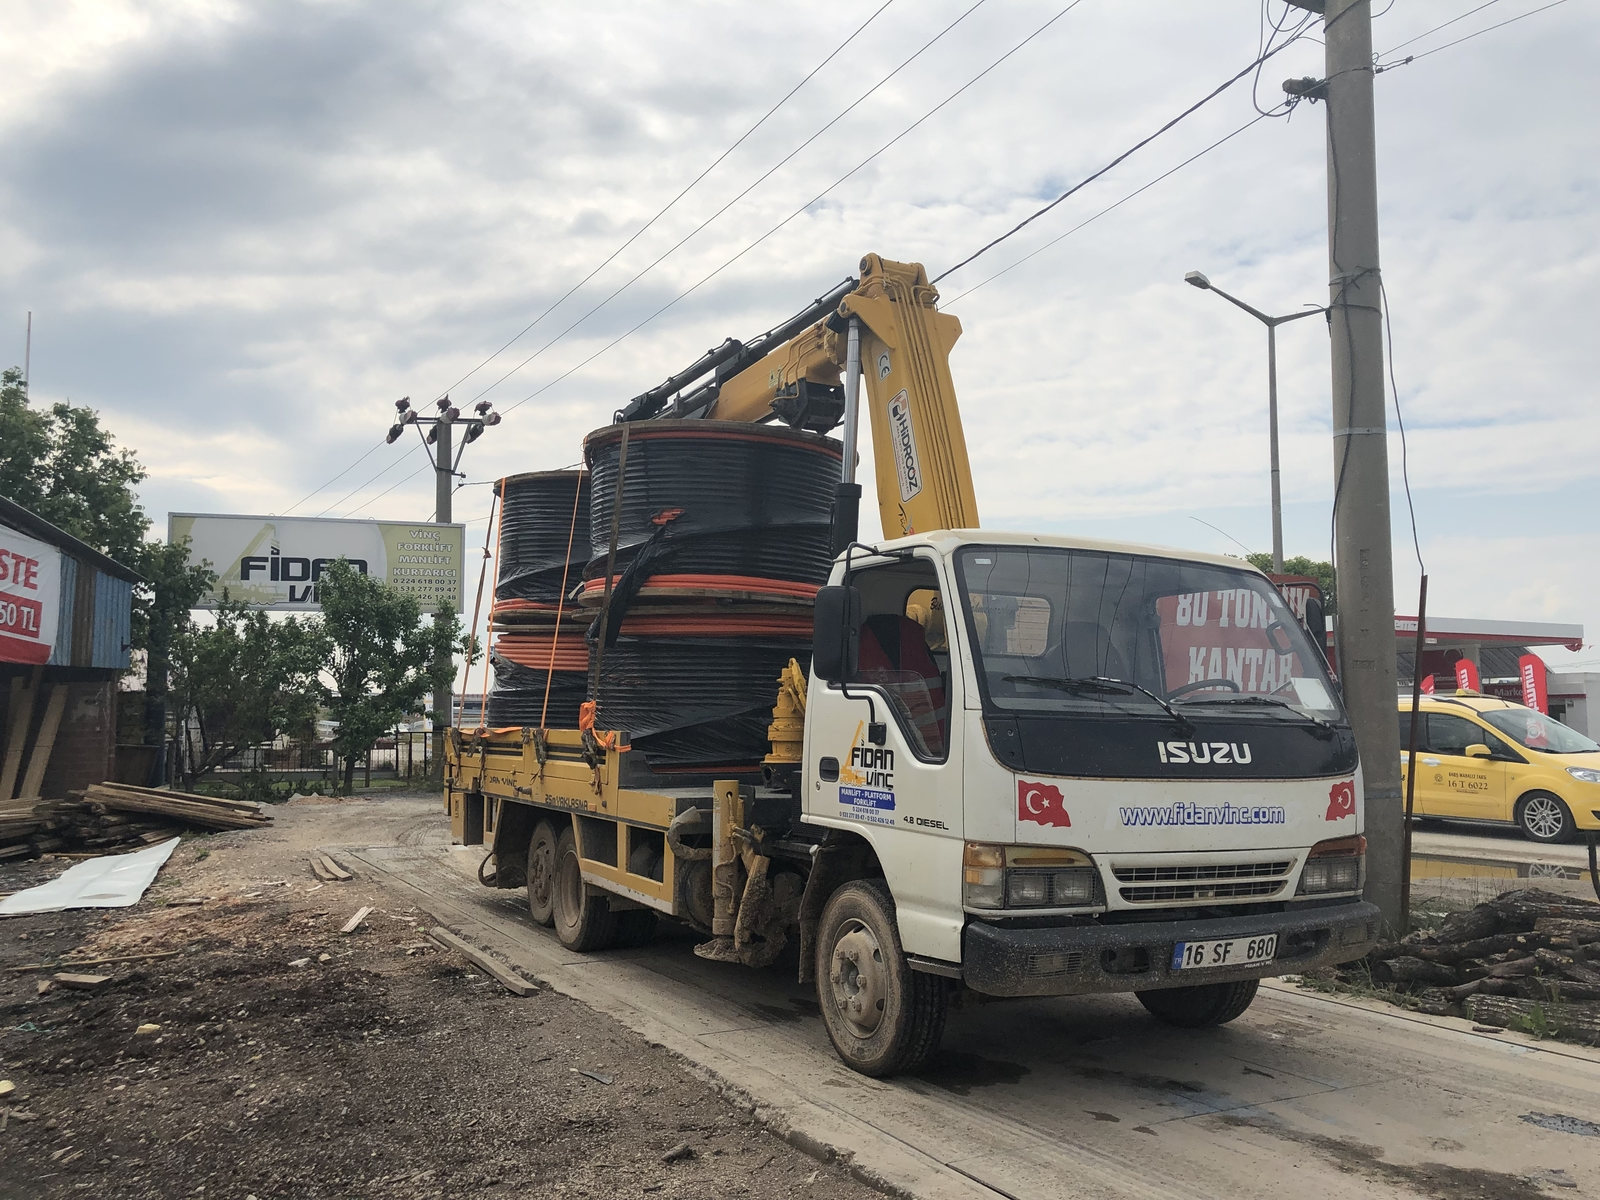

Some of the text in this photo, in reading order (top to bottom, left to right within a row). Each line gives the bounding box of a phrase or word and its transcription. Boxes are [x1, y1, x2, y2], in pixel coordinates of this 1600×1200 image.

[409, 529, 440, 541] VİNÇ
[397, 543, 453, 552] FORKLİFT
[399, 554, 451, 564] MANLİFT
[393, 568, 456, 577] KURTARICI
[21, 606, 37, 631] TL
[1188, 647, 1293, 692] KANTAR
[1494, 688, 1523, 697] Marke
[1157, 741, 1252, 764] ISUZU
[1459, 780, 1465, 788] T
[1468, 782, 1488, 790] 6022
[841, 788, 861, 797] MANLİFT
[864, 791, 892, 801] PLATFORM
[853, 798, 877, 807] FORKLİFT
[1119, 802, 1285, 826] www.fidanvinc.com
[916, 818, 949, 830] DIESEL
[1185, 944, 1205, 965] 16
[1212, 942, 1233, 963] SF
[1247, 937, 1274, 959] 680
